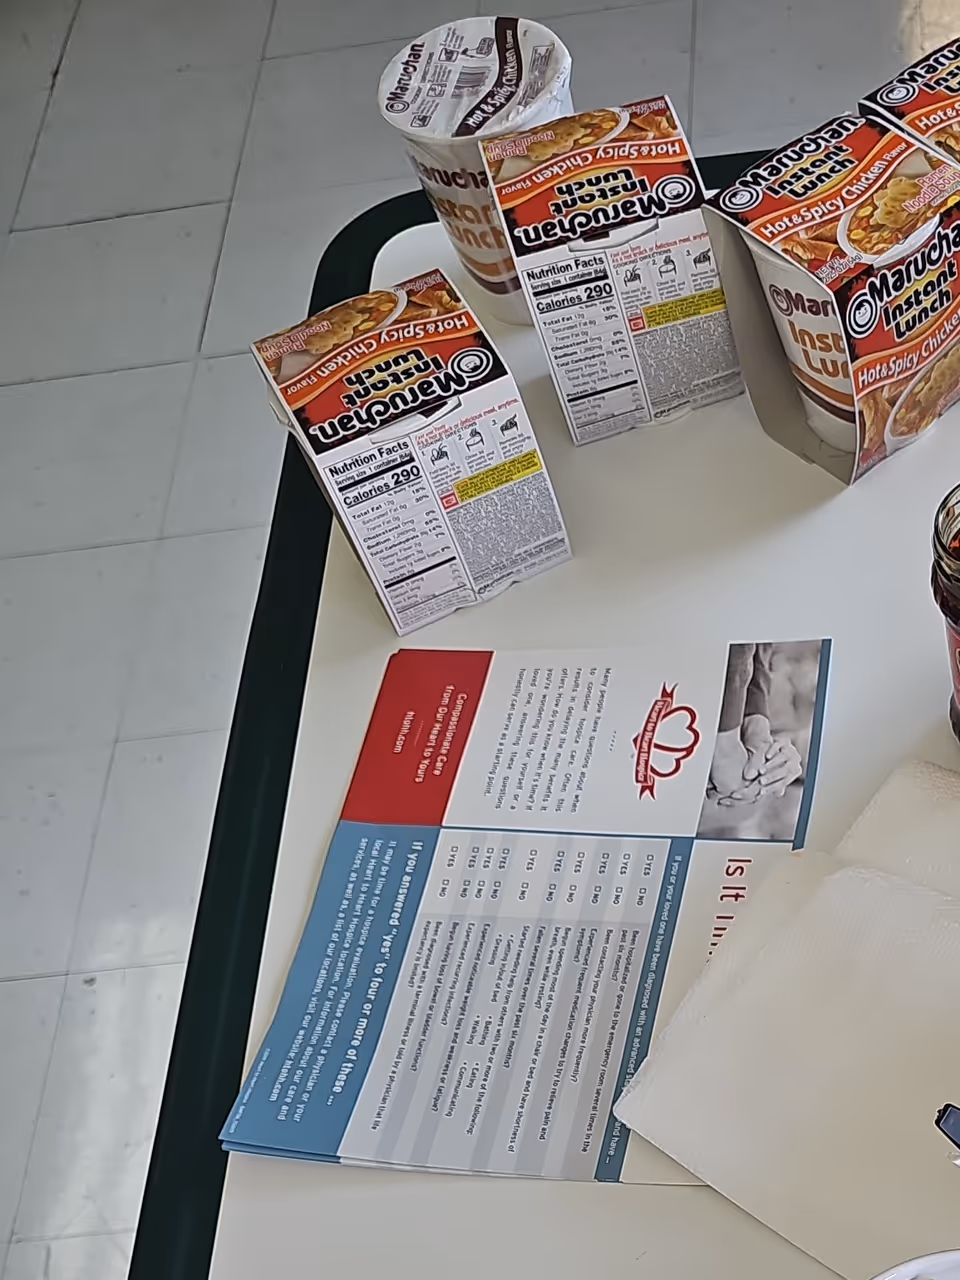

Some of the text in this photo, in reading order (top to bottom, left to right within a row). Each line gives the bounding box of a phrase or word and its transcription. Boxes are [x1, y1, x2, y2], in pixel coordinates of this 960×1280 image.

[503, 50, 518, 85] Chicken
[486, 97, 496, 111] &
[492, 84, 516, 108] Spicy
[465, 110, 485, 128] Hot
[534, 155, 593, 178] Chicken
[766, 145, 850, 195] Instant
[788, 157, 856, 199] Lunch
[842, 160, 888, 200] Chicken
[884, 142, 907, 162] Flavor
[917, 164, 951, 187] Ramen
[501, 179, 532, 195] Flavor
[557, 169, 634, 196] Lunch
[550, 179, 650, 214] Instant
[903, 186, 938, 212] Noodle
[526, 256, 604, 281] Nutrition Facts
[536, 282, 612, 312] Calories 290
[883, 260, 956, 325] Instant
[895, 289, 951, 339] Lunch
[317, 341, 378, 378] Chicken
[345, 348, 425, 387] Lunch
[287, 374, 317, 395] Flavor
[342, 355, 445, 407] Instant
[328, 441, 409, 477] Nutrition Facts
[334, 474, 355, 486] Serving
[373, 457, 398, 470] container
[343, 465, 420, 505] Calories 290
[647, 701, 664, 721] Heart
[414, 685, 454, 782] from Our Heart to Yours
[432, 693, 467, 775] Compassionate Care
[645, 723, 657, 731] to
[639, 731, 653, 751] Heart
[351, 837, 368, 870] services,
[381, 848, 393, 864] may
[411, 841, 423, 850] If
[379, 865, 389, 875] be
[405, 852, 418, 872] you
[670, 861, 678, 874] you
[721, 857, 752, 878] Is
[349, 872, 357, 881] as
[373, 877, 385, 894] time
[669, 875, 676, 883] or
[344, 883, 354, 898] well
[370, 896, 380, 907] for
[389, 875, 411, 925] answered
[665, 884, 674, 900] your
[717, 884, 748, 903] It
[660, 901, 672, 920] loved
[330, 932, 339, 941] of
[333, 919, 344, 931] list
[358, 916, 373, 945] hospice
[657, 921, 666, 934] one
[326, 942, 335, 956] our
[653, 935, 664, 952] have
[344, 947, 363, 988] evaluation.
[374, 962, 386, 974] to
[649, 953, 660, 970] been
[277, 839, 383, 1120] local Heart to Heart Hospice location. For information about our care and
[312, 957, 331, 994] locations,
[366, 977, 382, 1000] four
[641, 971, 655, 1008] diagnosed
[306, 996, 318, 1013] visit
[335, 991, 350, 1017] Please
[361, 1002, 372, 1015] or
[301, 1014, 311, 1027] our
[637, 1009, 646, 1025] with
[323, 1019, 339, 1047] contact
[350, 1018, 367, 1045] more
[634, 1026, 642, 1035] an
[287, 1029, 304, 1058] website:
[345, 1048, 356, 1060] of
[626, 1037, 640, 1073] advanced
[269, 1059, 292, 1101] htohh.com
[305, 1055, 324, 1090] physician
[332, 1062, 353, 1092] these
[301, 1092, 309, 1101] or
[293, 1103, 305, 1121] your
[607, 1121, 621, 1155] and have
